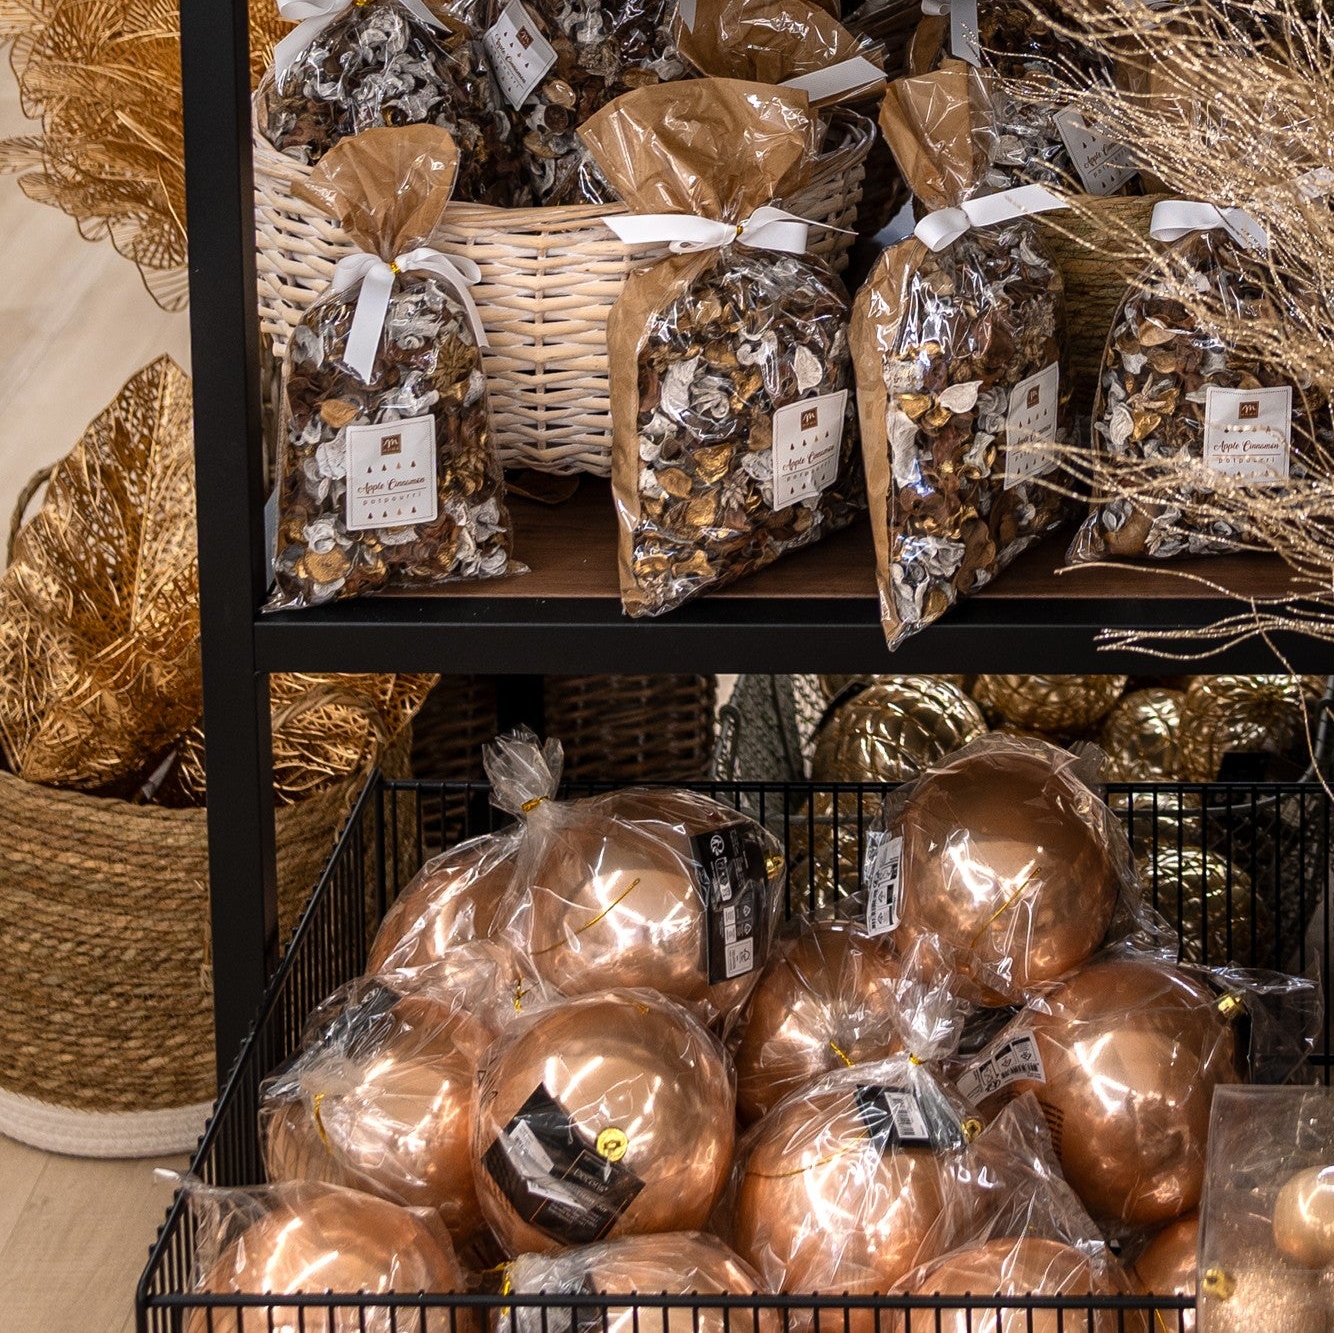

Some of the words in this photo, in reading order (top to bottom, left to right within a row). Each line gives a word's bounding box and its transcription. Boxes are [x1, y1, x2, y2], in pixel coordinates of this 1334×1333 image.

[1213, 440, 1239, 452] Apple
[1242, 440, 1280, 452] Cinnamon
[357, 482, 384, 494] Apple
[388, 477, 425, 491] Cinnamon
[362, 492, 422, 506] potpourri
